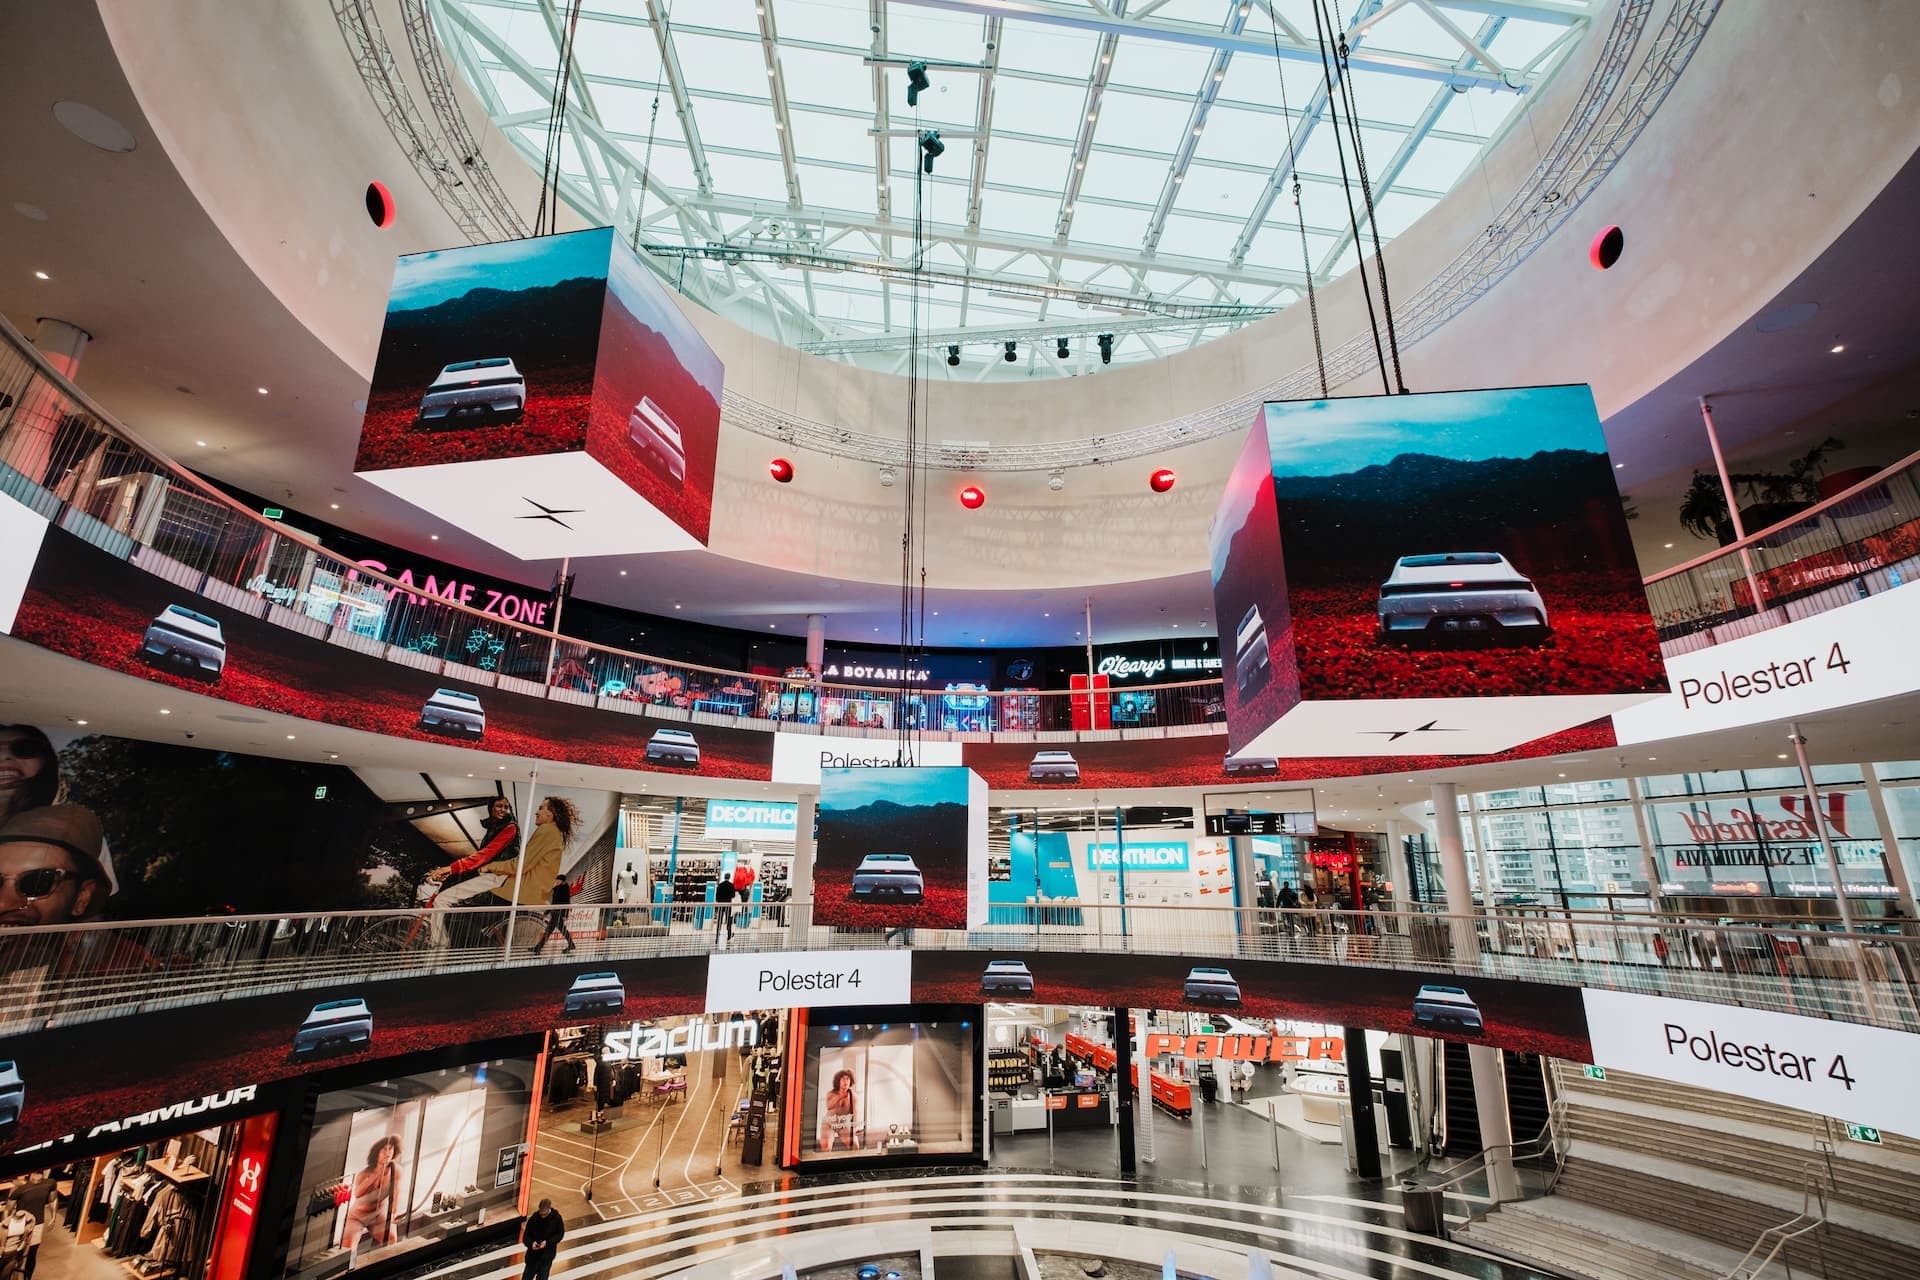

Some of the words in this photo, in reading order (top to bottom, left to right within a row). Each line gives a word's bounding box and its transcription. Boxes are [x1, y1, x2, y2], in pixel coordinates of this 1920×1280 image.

[482, 590, 548, 625] ZONE
[844, 666, 928, 681] BOTANICA
[1098, 655, 1166, 678] O'Learys
[1678, 656, 1817, 709] Polestar
[1826, 642, 1851, 675] 4
[711, 805, 797, 825] DECATHLO
[1212, 819, 1218, 833] 1
[759, 970, 844, 991] Polestar
[848, 969, 862, 988] 4
[602, 1018, 758, 1061] stadium
[1146, 1034, 1345, 1060] POWER
[1663, 1023, 1816, 1082] Polestar
[1828, 1055, 1856, 1091] 4
[88, 1084, 257, 1138] ARMOUR
